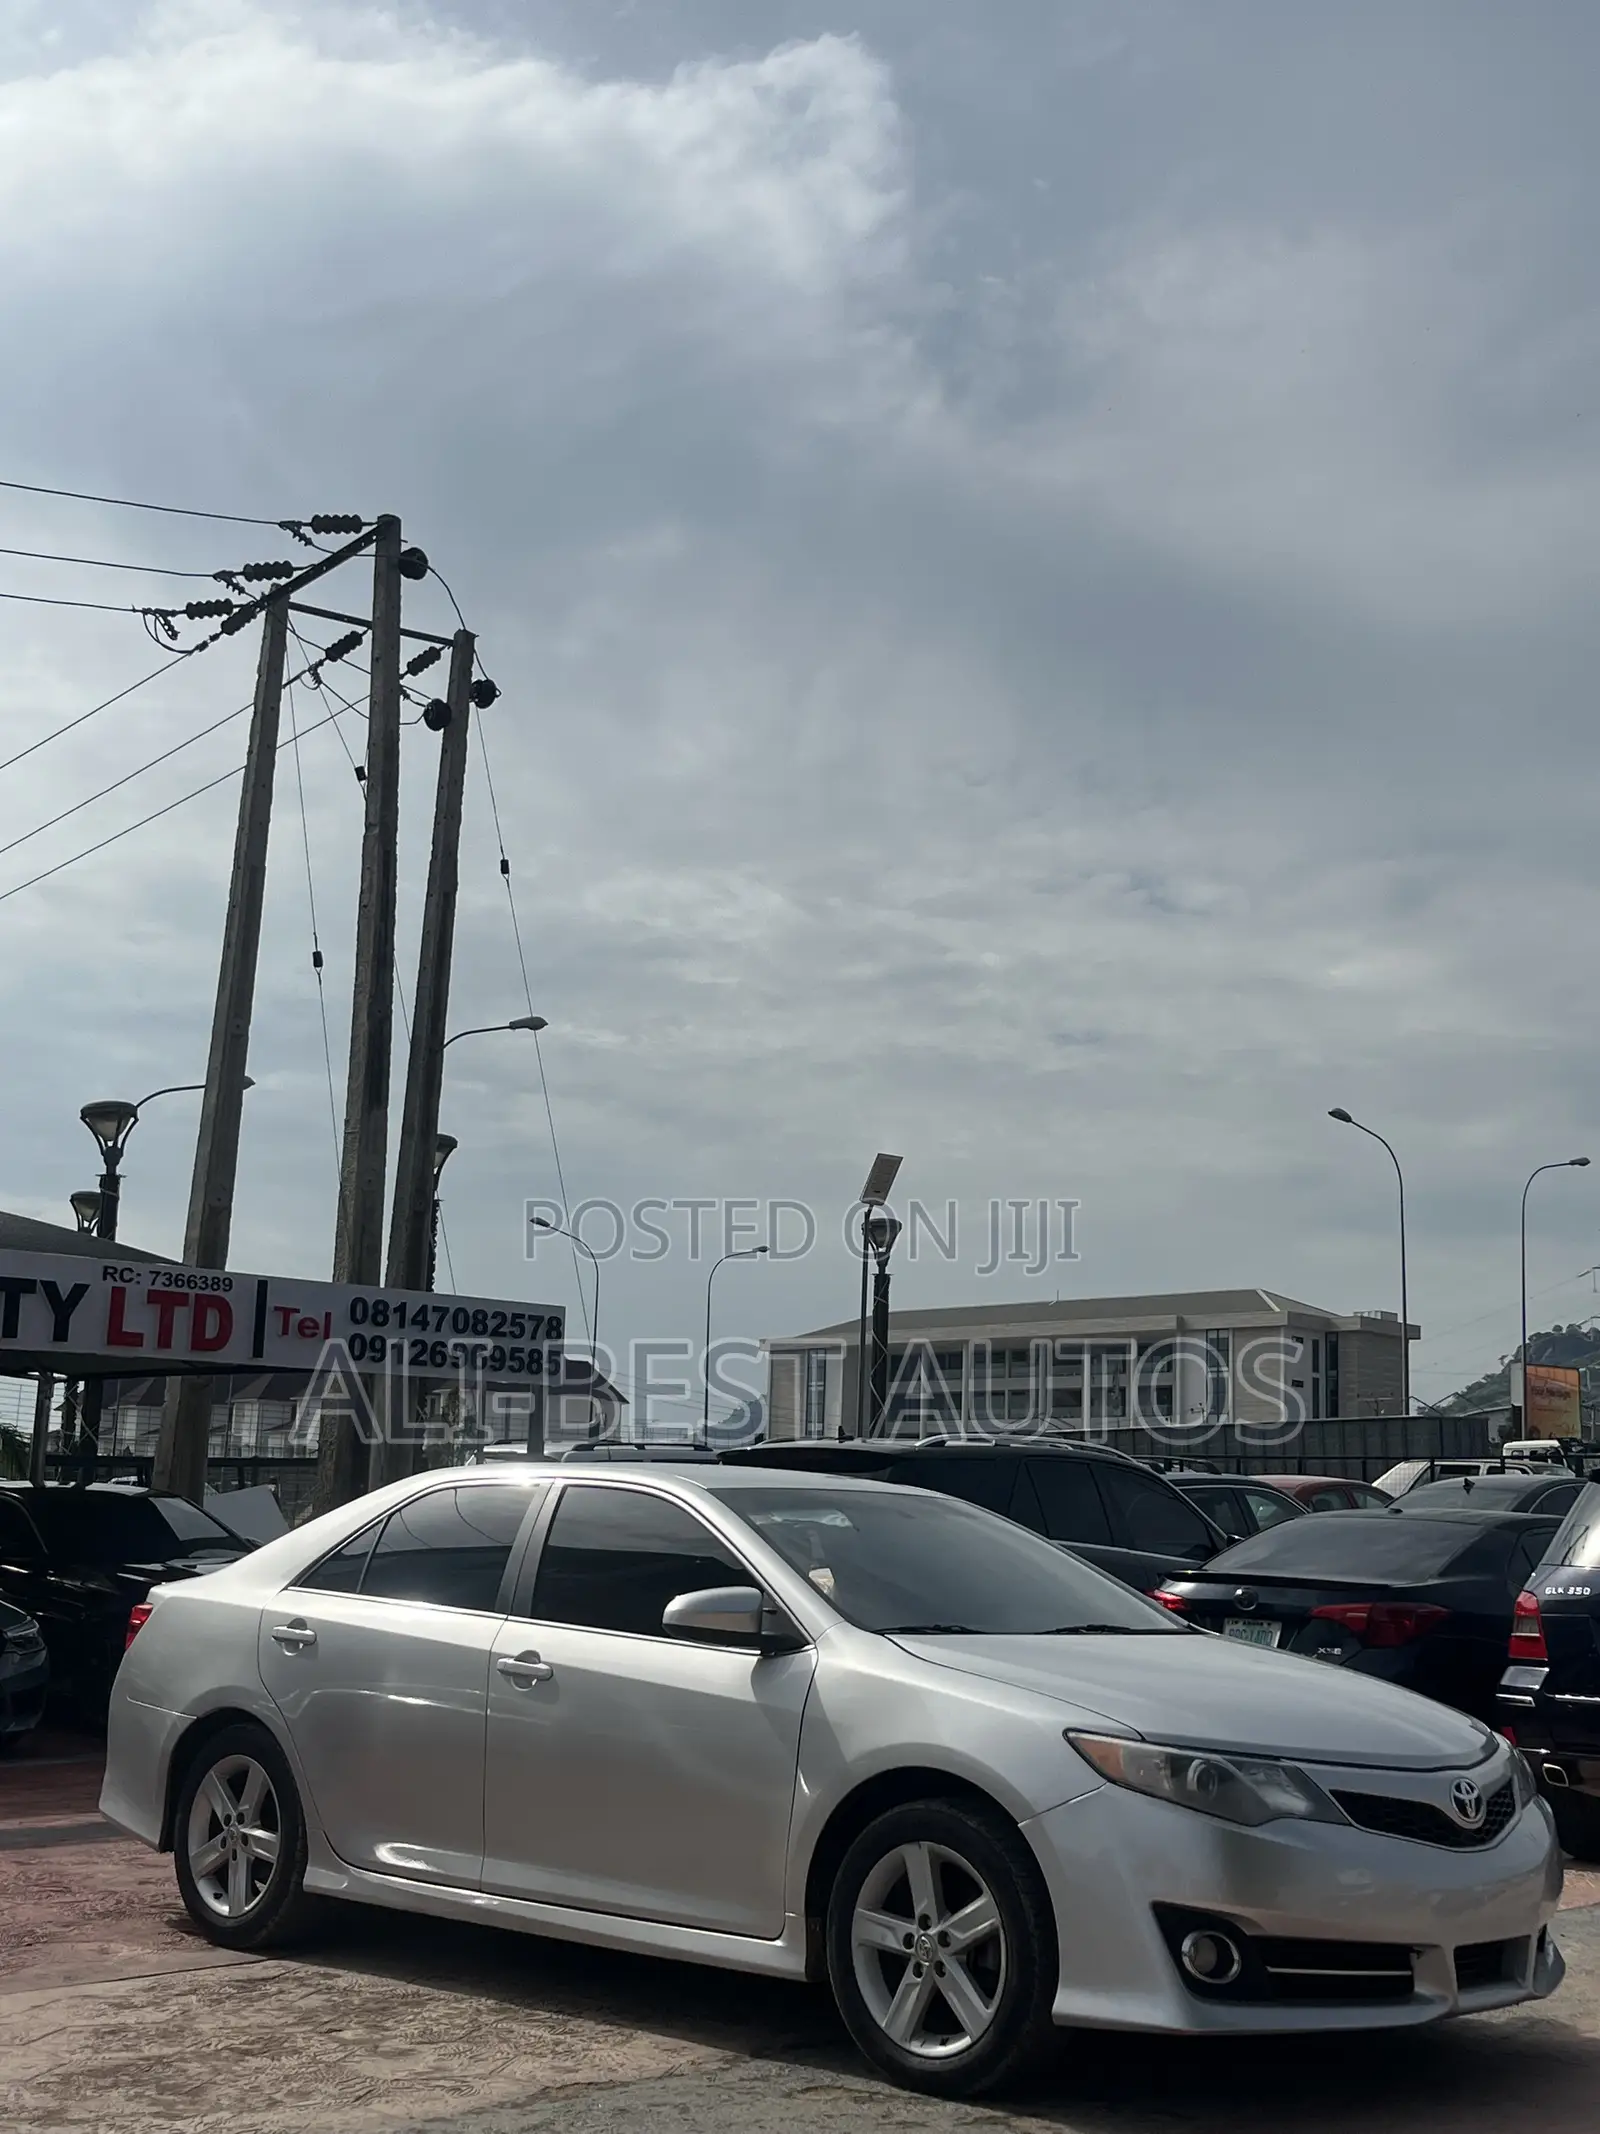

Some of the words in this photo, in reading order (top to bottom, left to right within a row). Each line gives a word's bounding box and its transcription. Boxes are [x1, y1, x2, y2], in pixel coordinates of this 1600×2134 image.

[102, 1265, 141, 1285] RC:
[149, 1270, 234, 1293] 7366389
[0, 1275, 91, 1343] TY
[106, 1286, 234, 1352] LTD
[274, 1305, 332, 1340] Tel
[350, 1297, 562, 1340] 08147082578
[1545, 1586, 1565, 1595] GLK
[1567, 1586, 1591, 1596] 350
